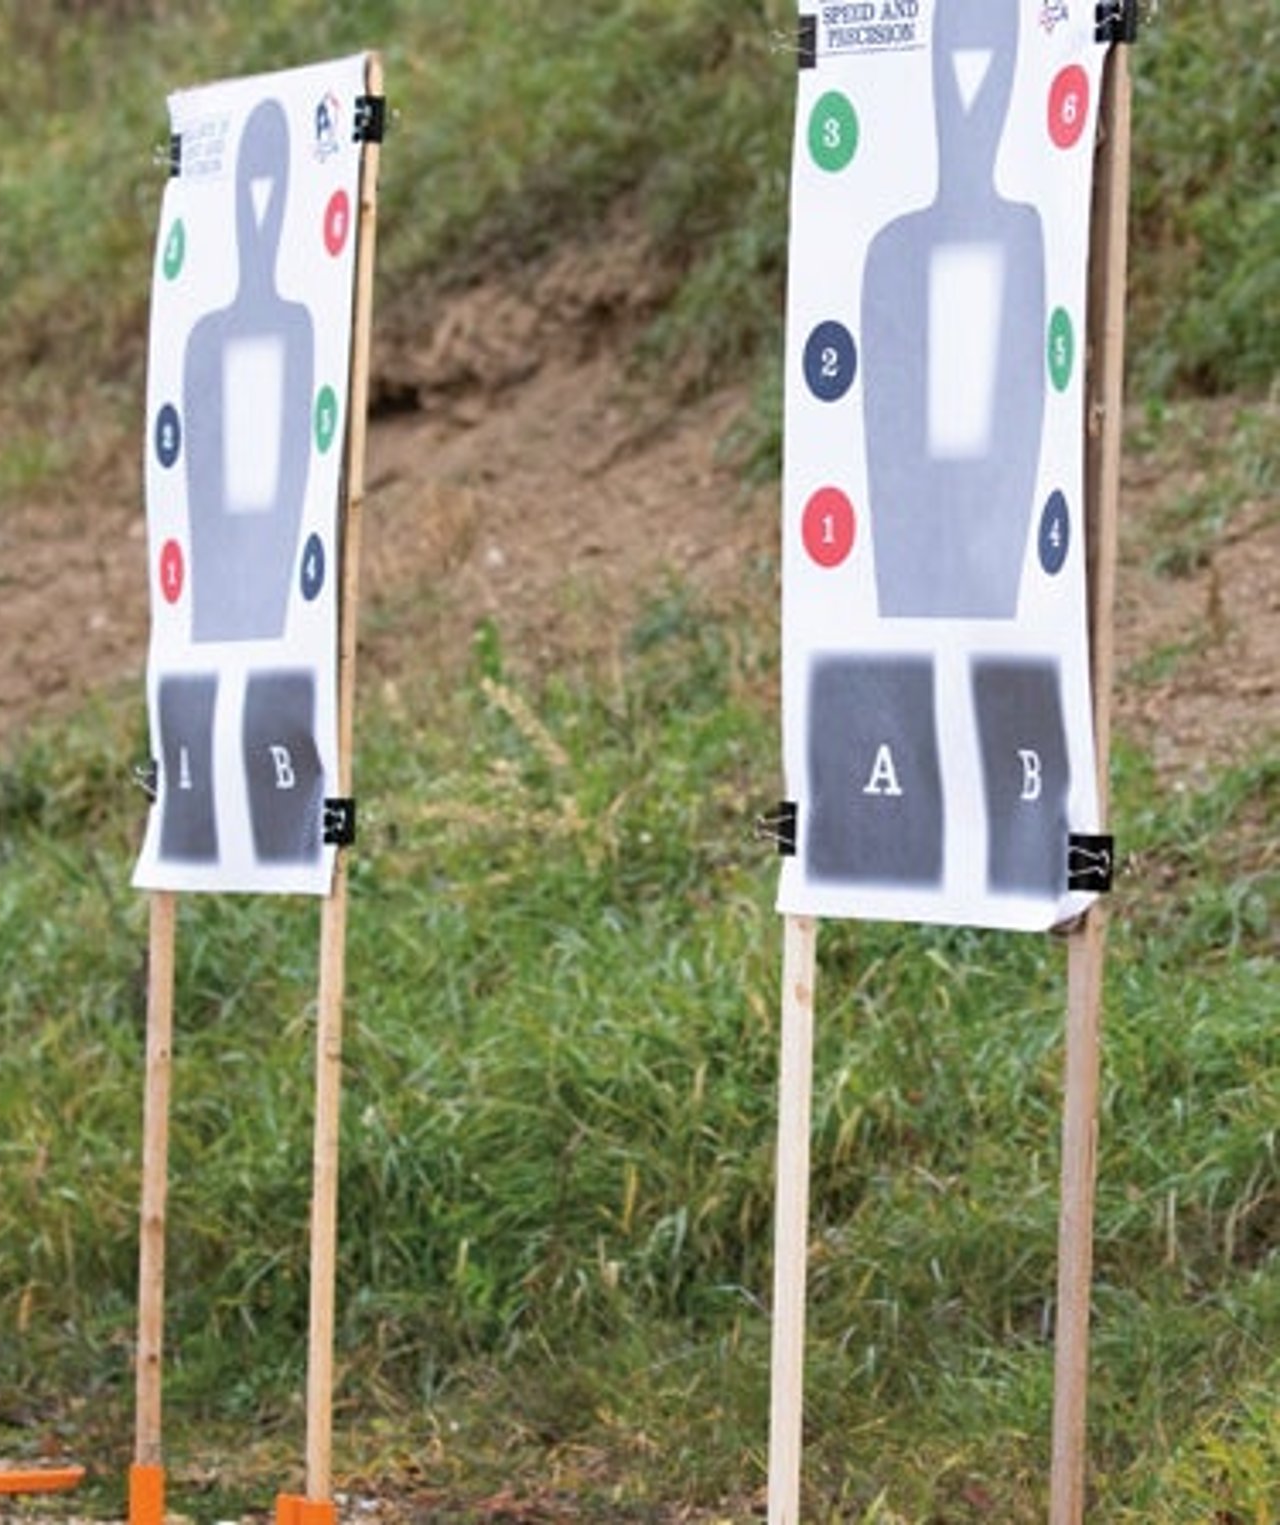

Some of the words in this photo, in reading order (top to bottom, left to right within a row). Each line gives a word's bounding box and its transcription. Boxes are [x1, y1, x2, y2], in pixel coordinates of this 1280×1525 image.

[822, 3, 875, 24] SPEED
[880, 0, 919, 20] AND
[828, 23, 915, 48] PRECISION
[1061, 93, 1077, 125] 6
[823, 118, 841, 149] 3
[820, 347, 838, 378] 2
[821, 515, 835, 544] 1
[1049, 518, 1061, 548] 4
[269, 744, 296, 790] B
[862, 744, 903, 796] A
[1017, 748, 1043, 801] B
